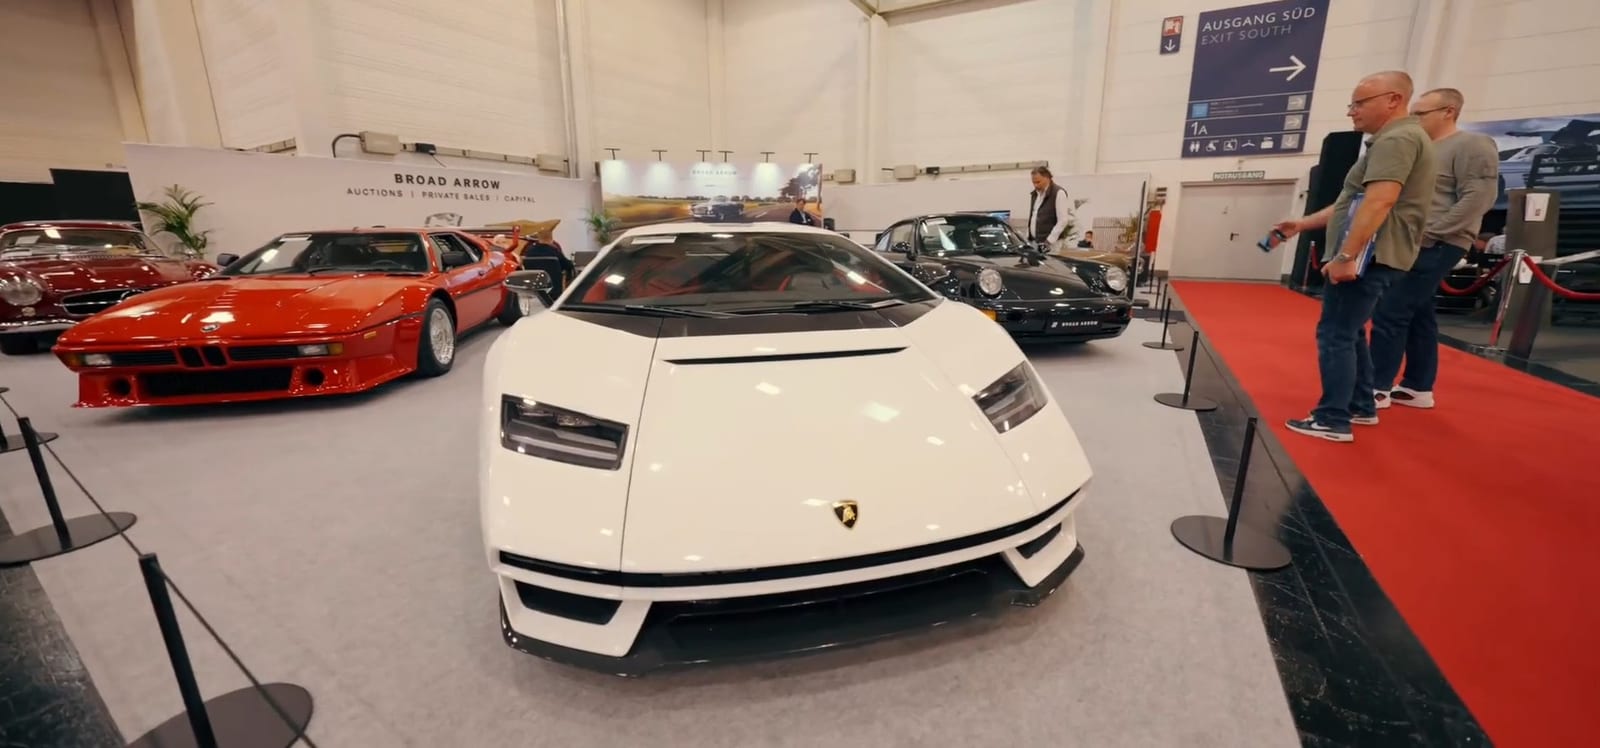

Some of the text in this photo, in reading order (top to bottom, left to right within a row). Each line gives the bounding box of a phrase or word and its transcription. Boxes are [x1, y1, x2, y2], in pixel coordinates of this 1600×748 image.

[1202, 7, 1316, 32] AUSGANG SÜD
[1201, 24, 1292, 46] EXIT SOUTH
[1191, 121, 1208, 136] 1A
[394, 173, 501, 190] BROAD ARROW
[347, 187, 536, 203] AUCTIONS PRIVATE SALES CAPITAL
